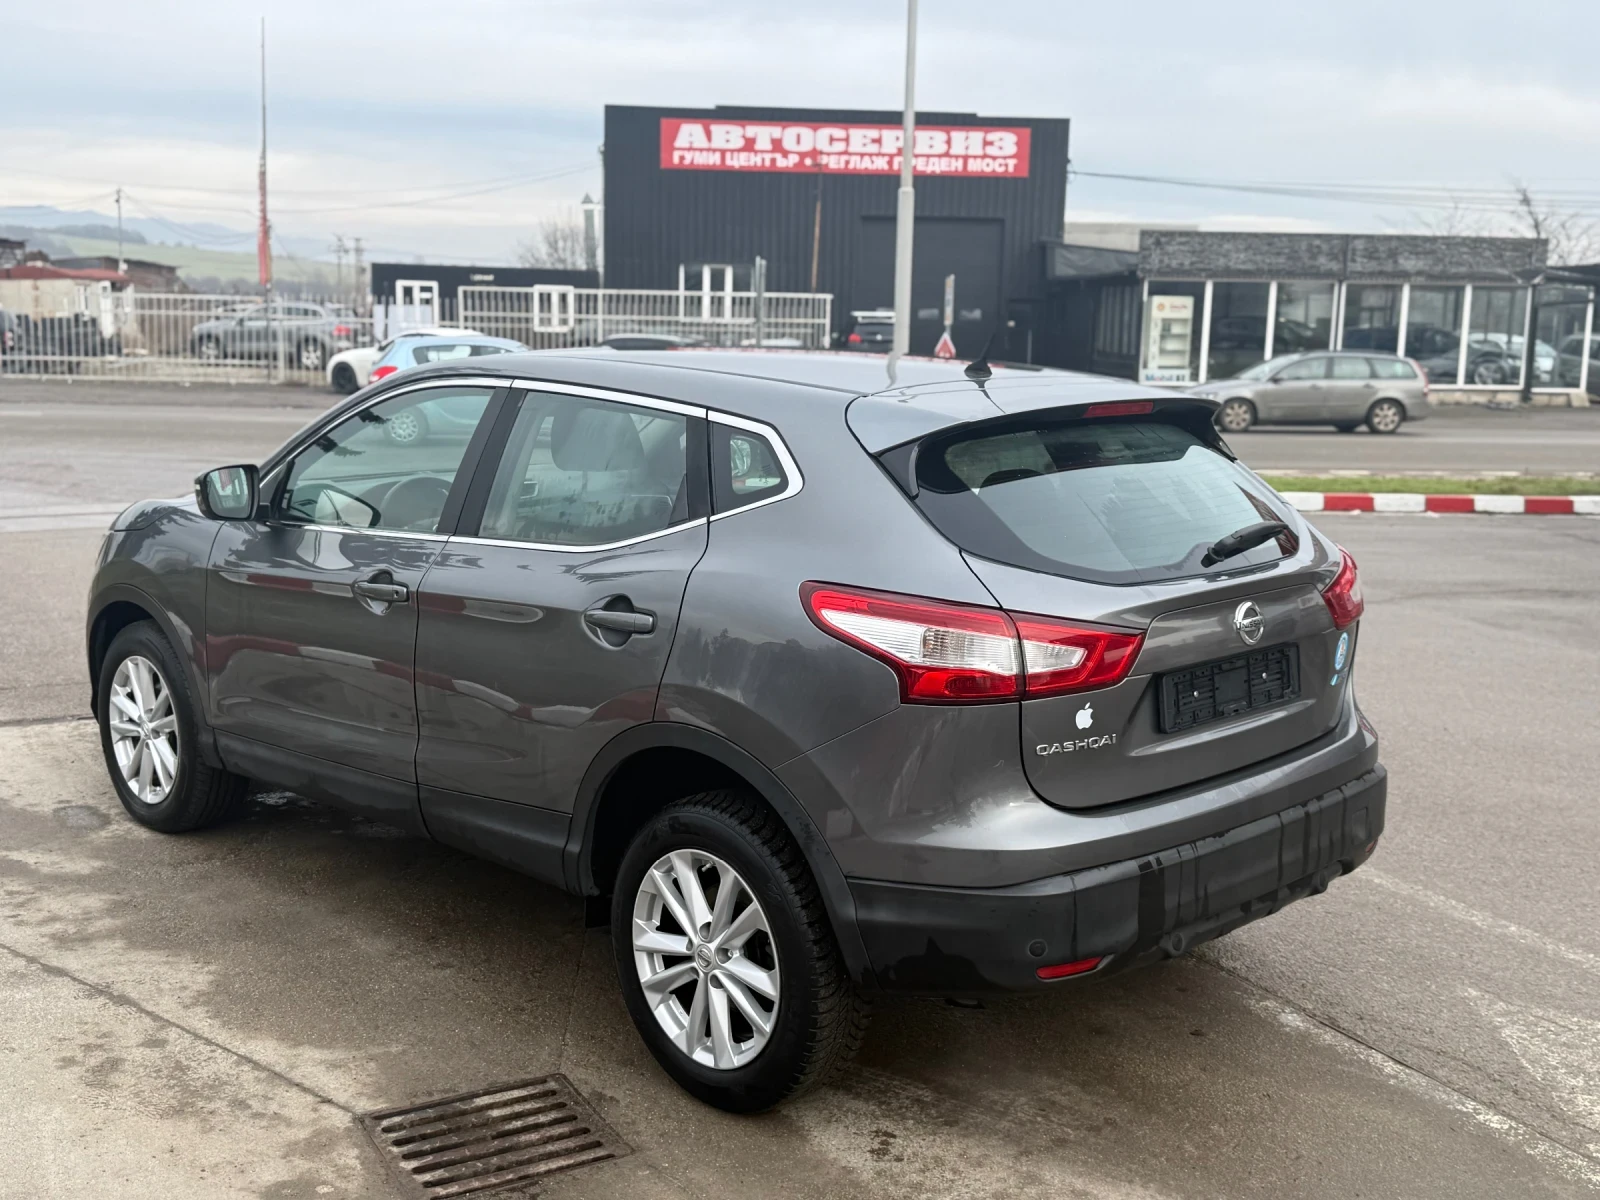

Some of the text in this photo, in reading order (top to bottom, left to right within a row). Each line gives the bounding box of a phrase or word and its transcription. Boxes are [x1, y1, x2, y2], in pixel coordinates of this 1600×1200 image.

[674, 123, 1018, 157] АВТОСЕРВИЗ
[672, 150, 721, 166] ГУМИ
[725, 151, 799, 168] ЦЕНТЪР
[967, 158, 1018, 173] МОСТ
